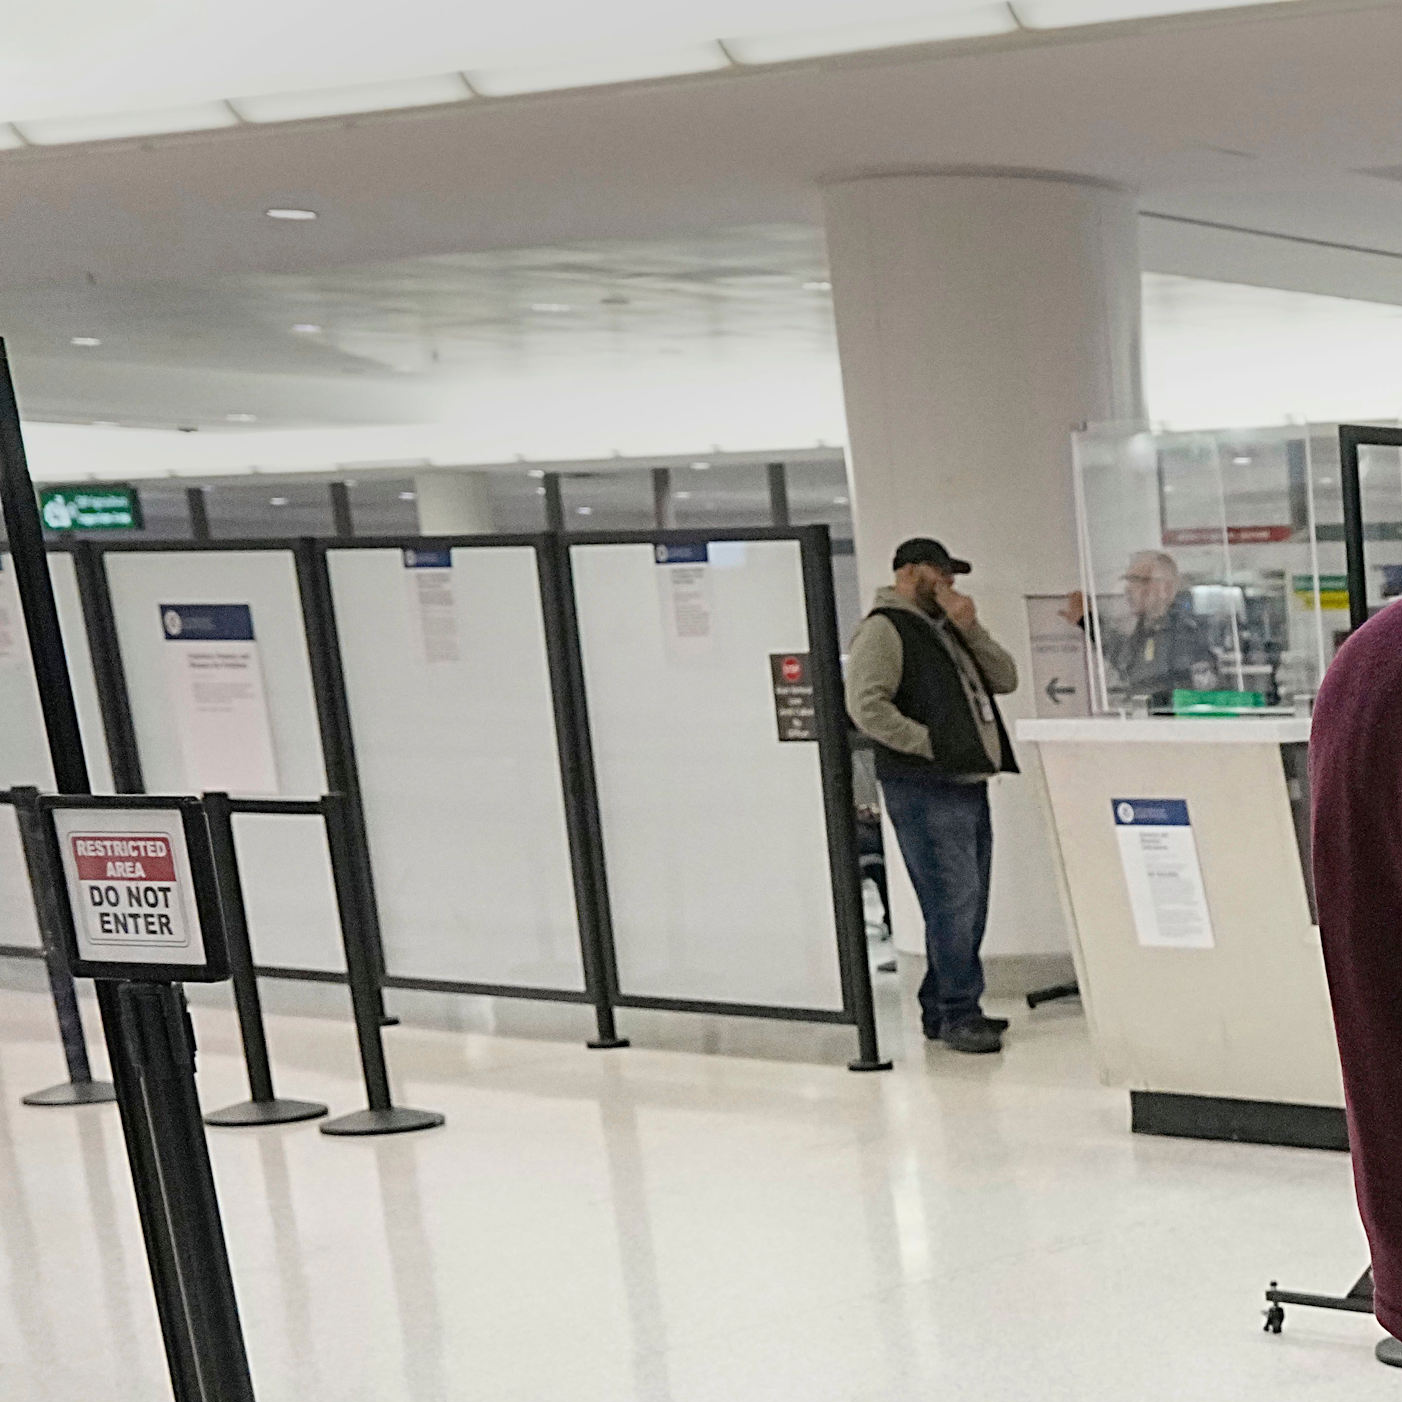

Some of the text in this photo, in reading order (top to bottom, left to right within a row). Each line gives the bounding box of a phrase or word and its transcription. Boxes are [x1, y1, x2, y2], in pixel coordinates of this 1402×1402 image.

[75, 839, 168, 858] RESTRICTED
[106, 861, 147, 878] AREA
[89, 885, 172, 909] DO NOT
[98, 912, 174, 936] ENTER
